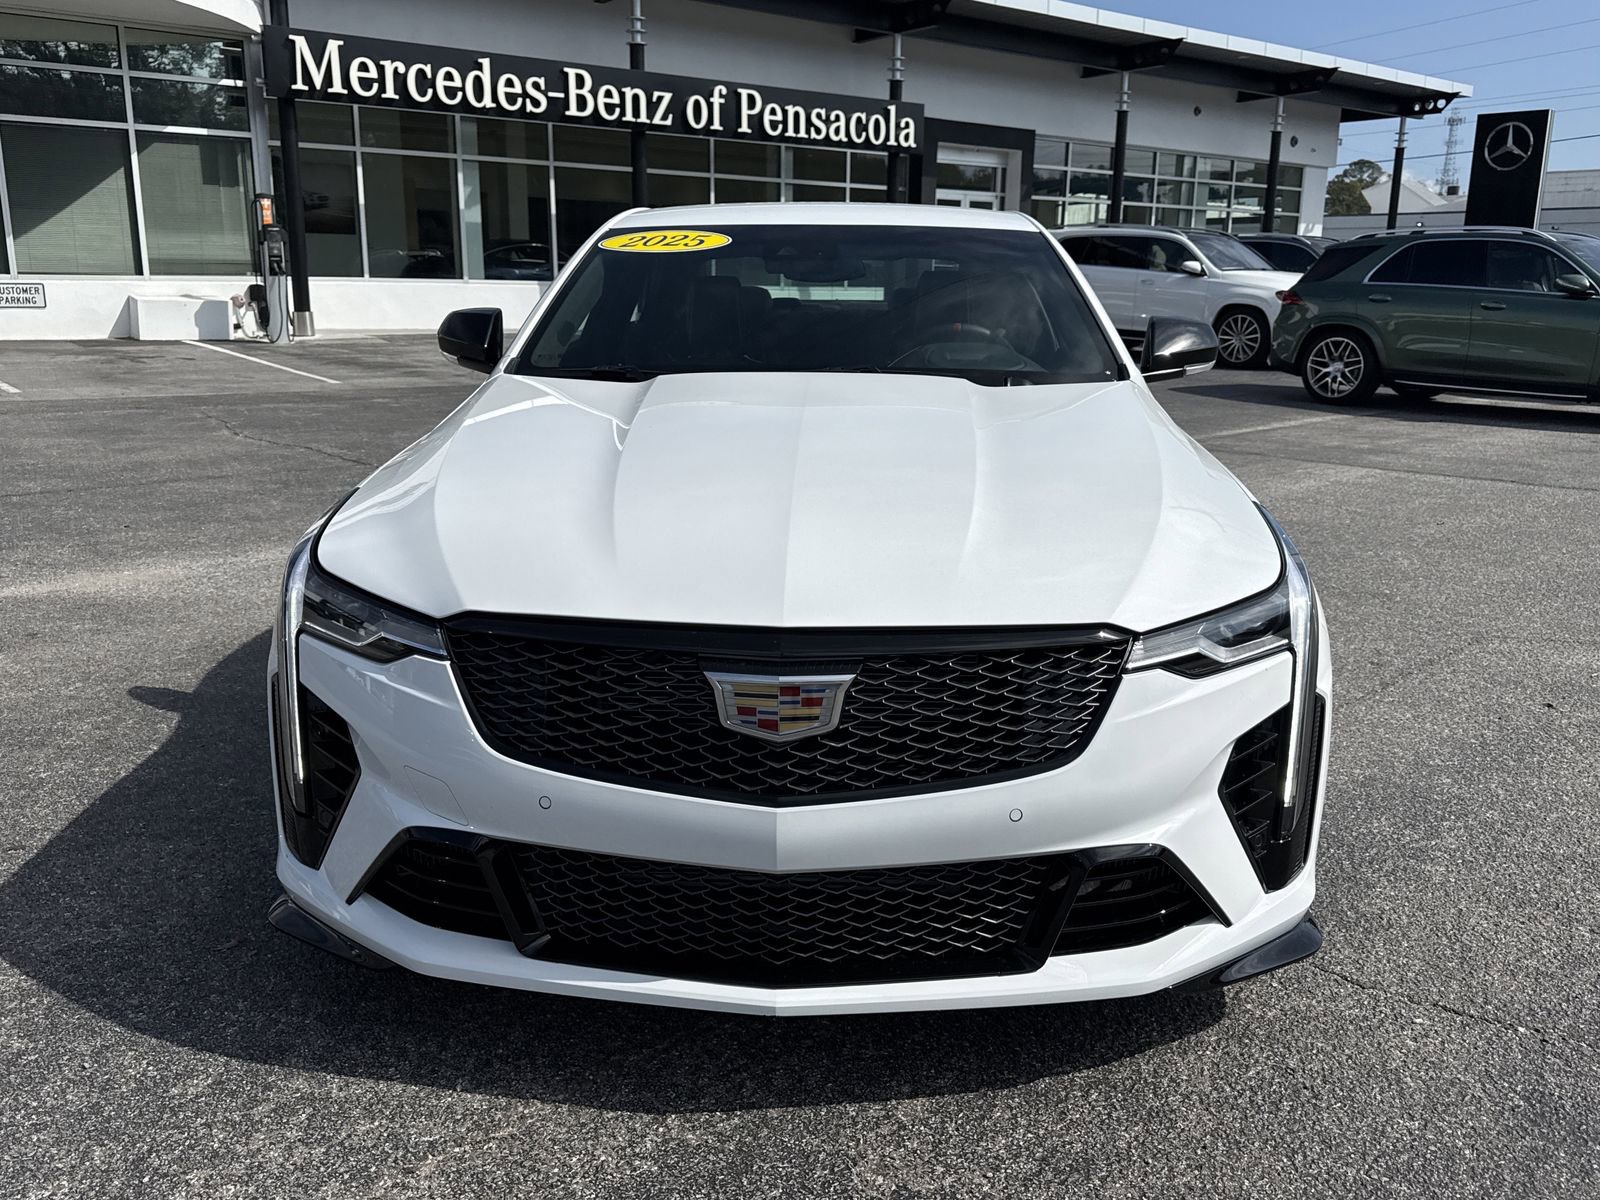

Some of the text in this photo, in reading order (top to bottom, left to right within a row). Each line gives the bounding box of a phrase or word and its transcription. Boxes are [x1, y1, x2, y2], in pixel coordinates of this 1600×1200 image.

[288, 34, 917, 148] Mercedes-Benz of Pensacola
[618, 235, 712, 248] 2025
[0, 286, 40, 295] USTOMER
[0, 296, 37, 305] PARKING
